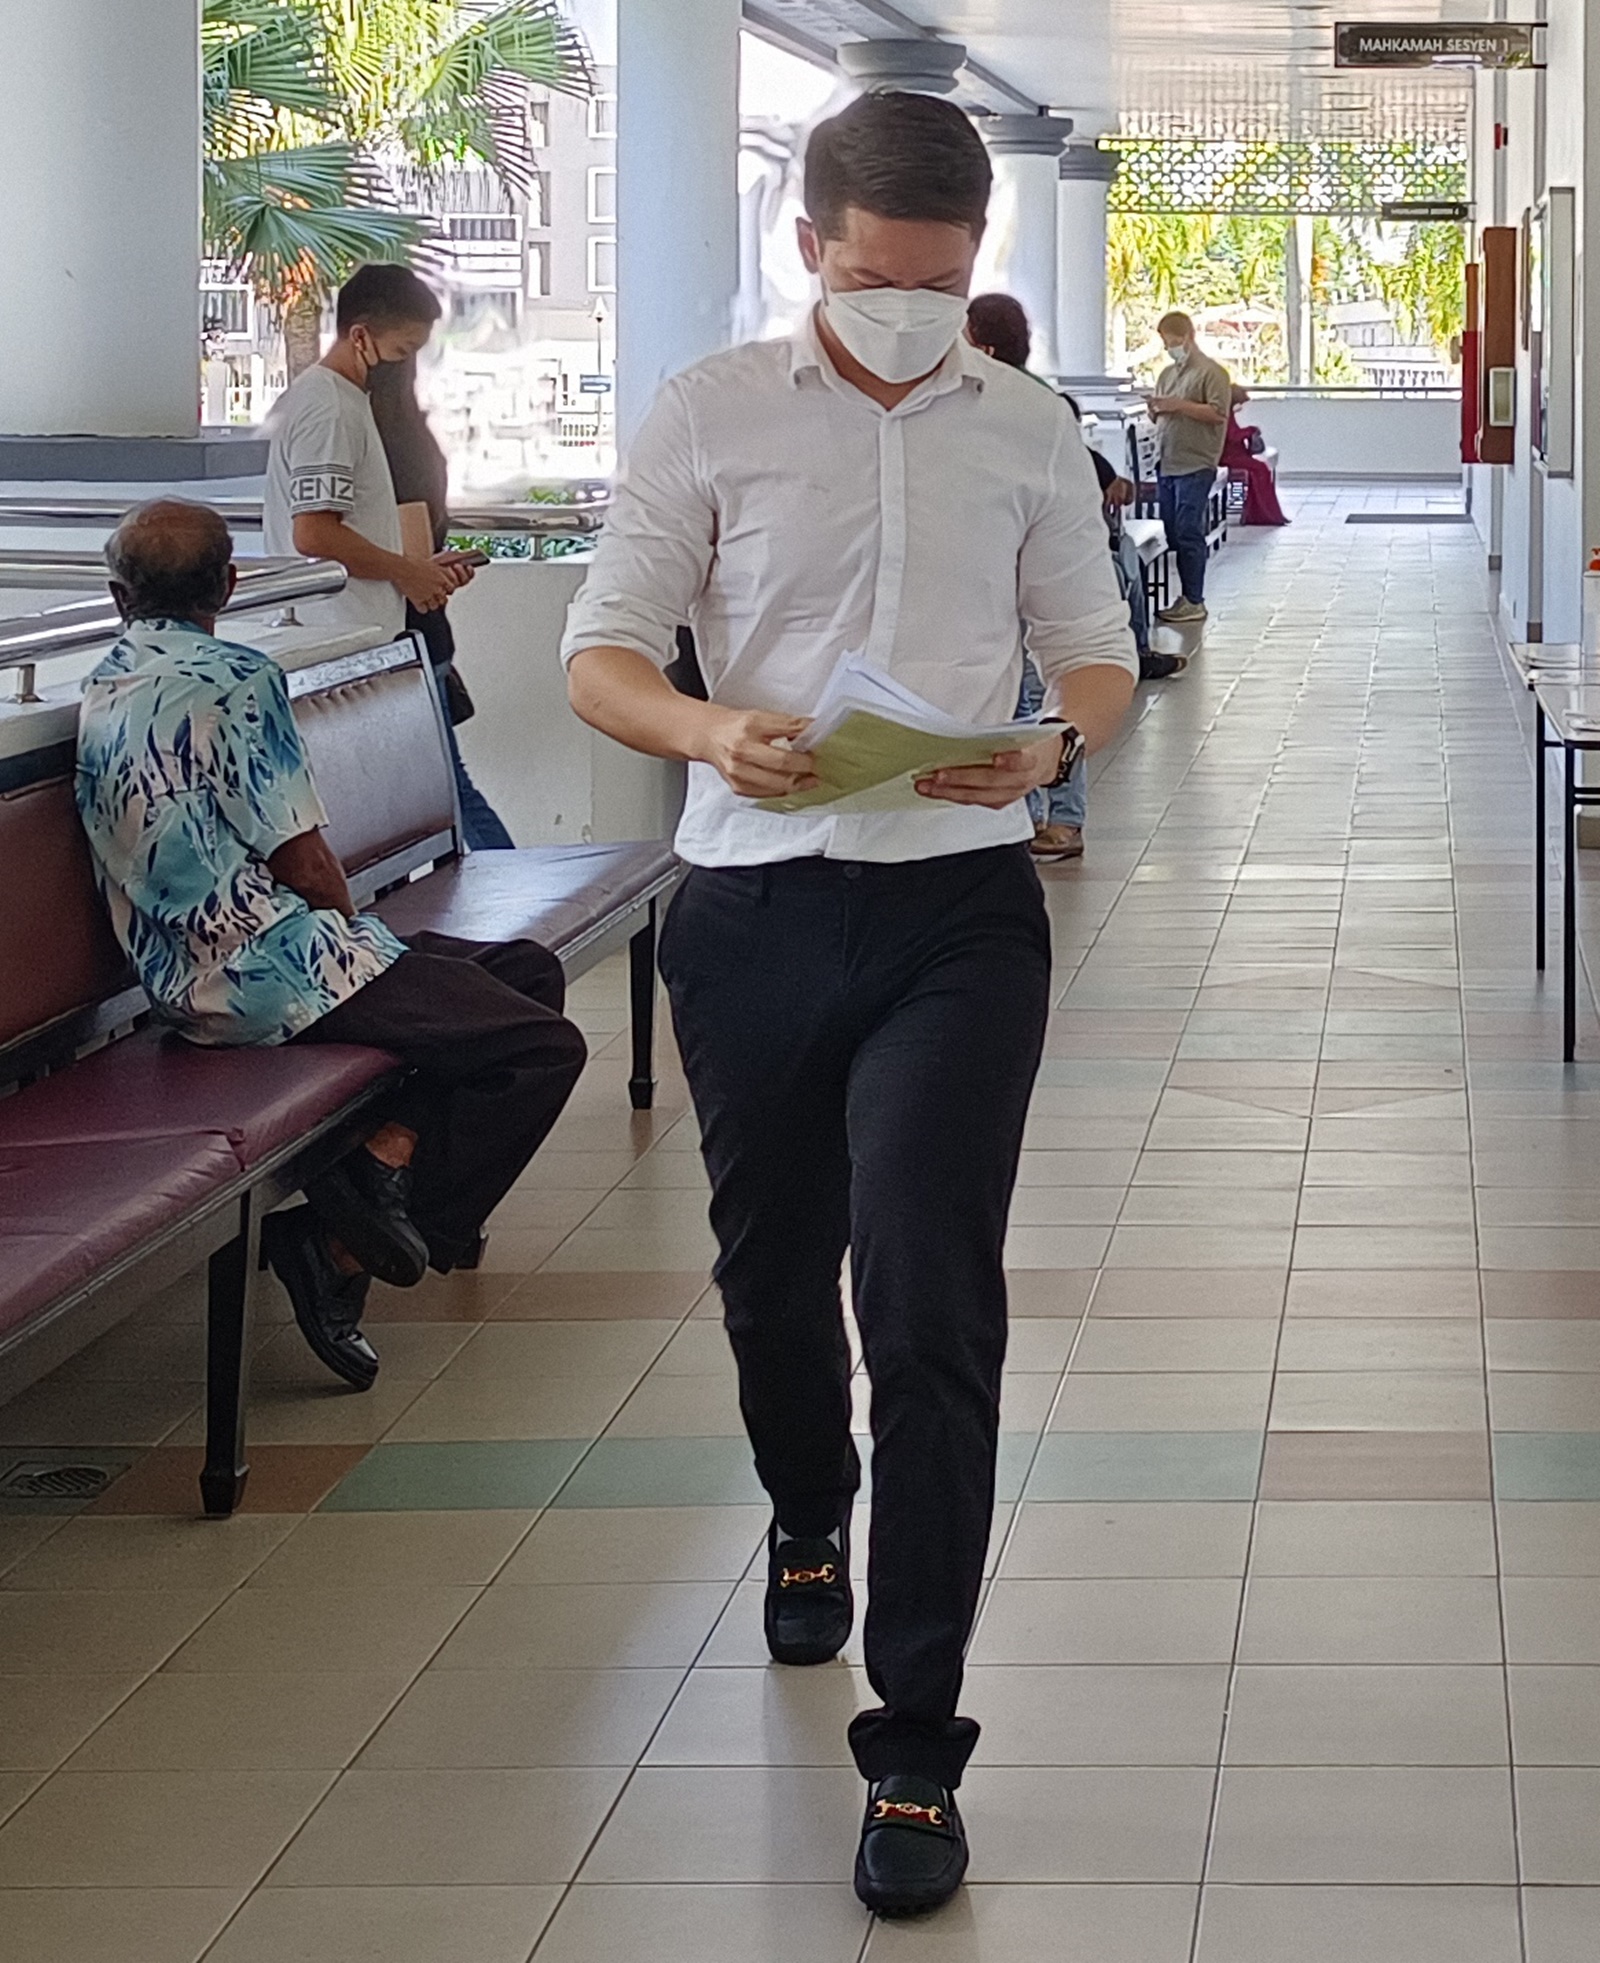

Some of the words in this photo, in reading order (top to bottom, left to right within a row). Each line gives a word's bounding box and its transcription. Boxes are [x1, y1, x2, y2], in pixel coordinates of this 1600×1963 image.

[1359, 38, 1442, 52] MAHKAMAH
[1446, 38, 1496, 52] SESYEN
[1502, 39, 1508, 52] 1
